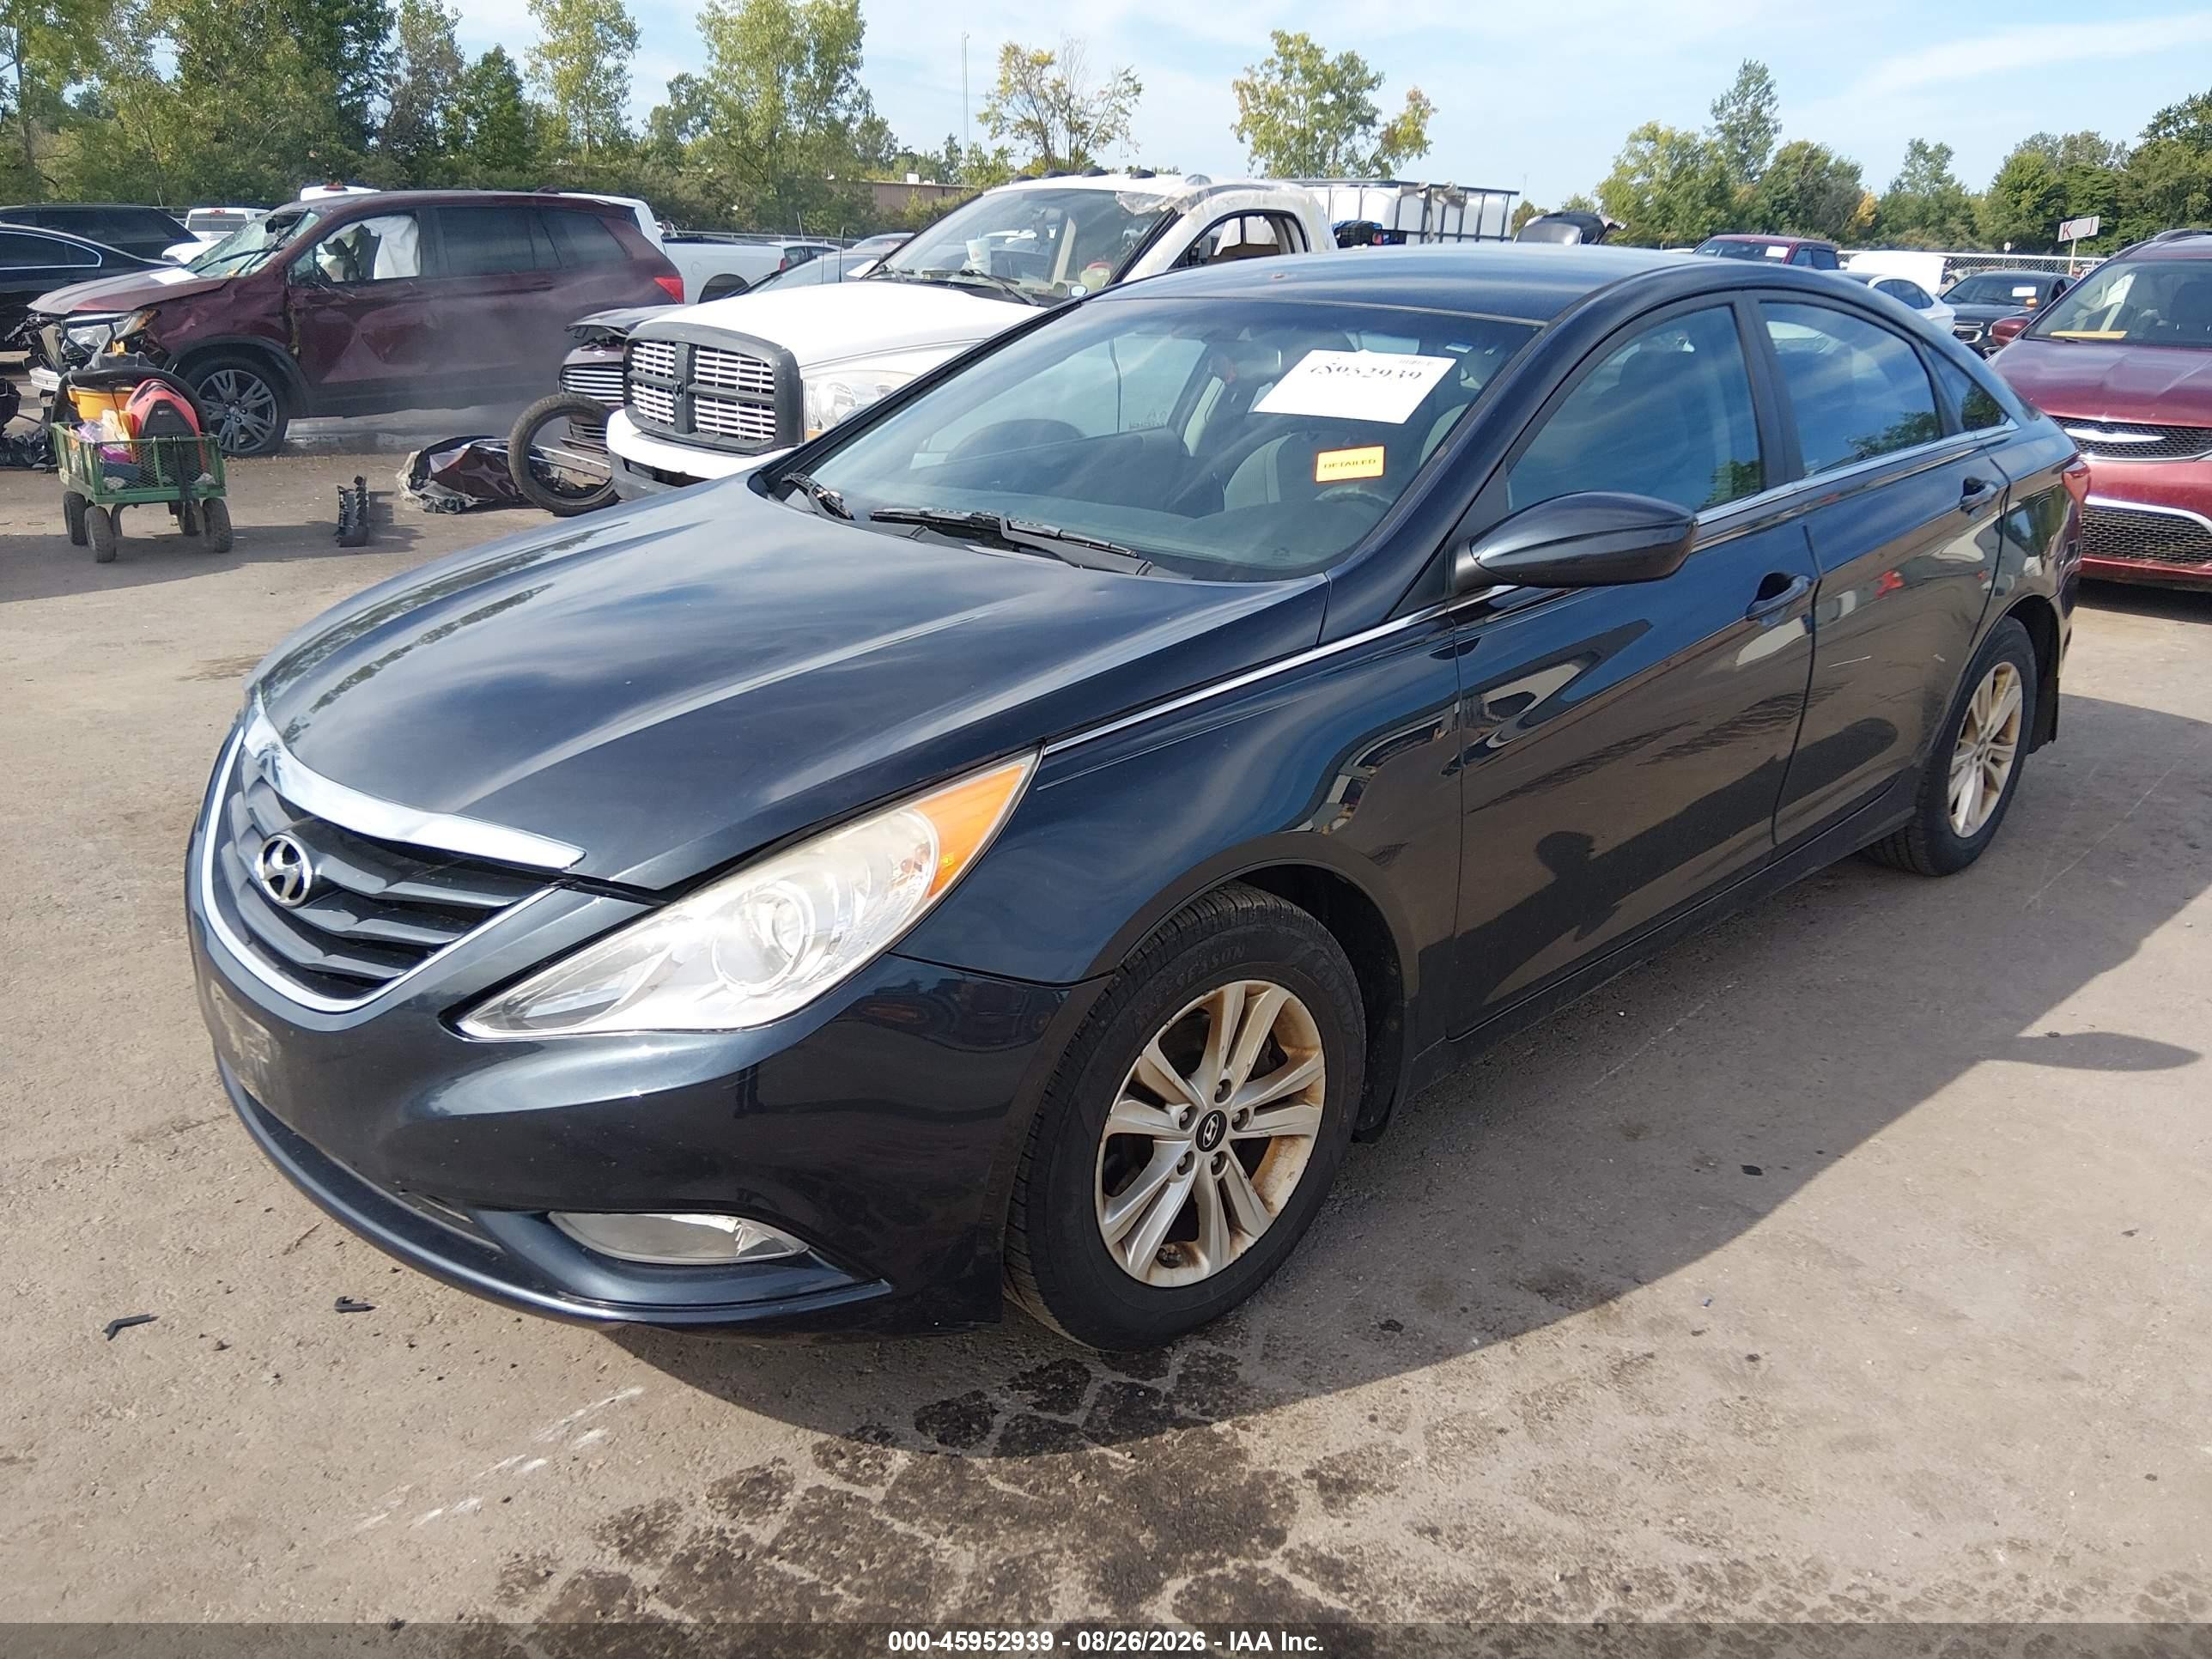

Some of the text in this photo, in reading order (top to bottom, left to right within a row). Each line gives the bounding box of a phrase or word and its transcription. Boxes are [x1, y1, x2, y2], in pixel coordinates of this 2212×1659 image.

[2062, 217, 2094, 240] K J
[1323, 458, 1376, 469] DETAILED
